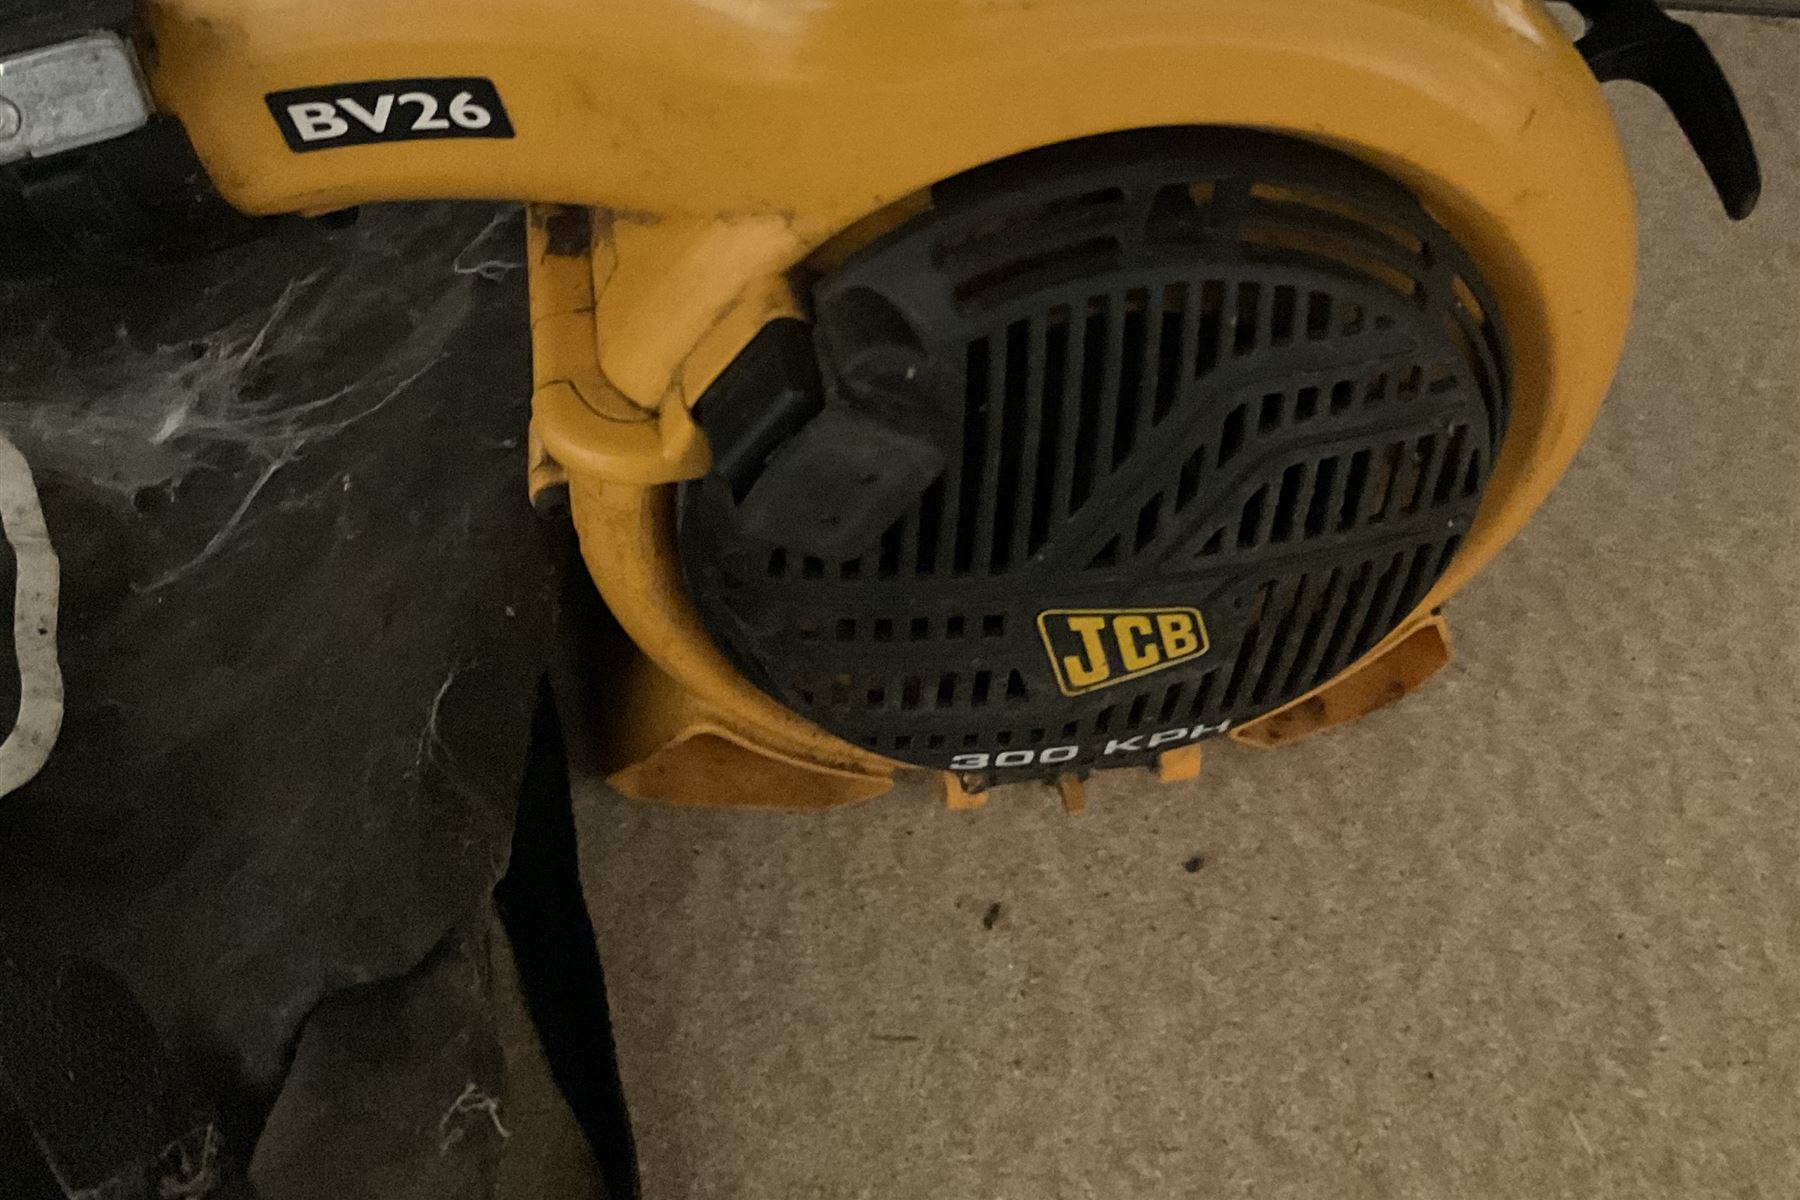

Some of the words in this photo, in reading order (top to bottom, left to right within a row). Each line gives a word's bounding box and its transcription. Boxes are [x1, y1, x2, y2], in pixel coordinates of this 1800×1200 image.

[286, 92, 491, 142] BV26
[1063, 613, 1198, 687] JCB
[950, 744, 1079, 770] 300
[1103, 718, 1231, 755] KPH
